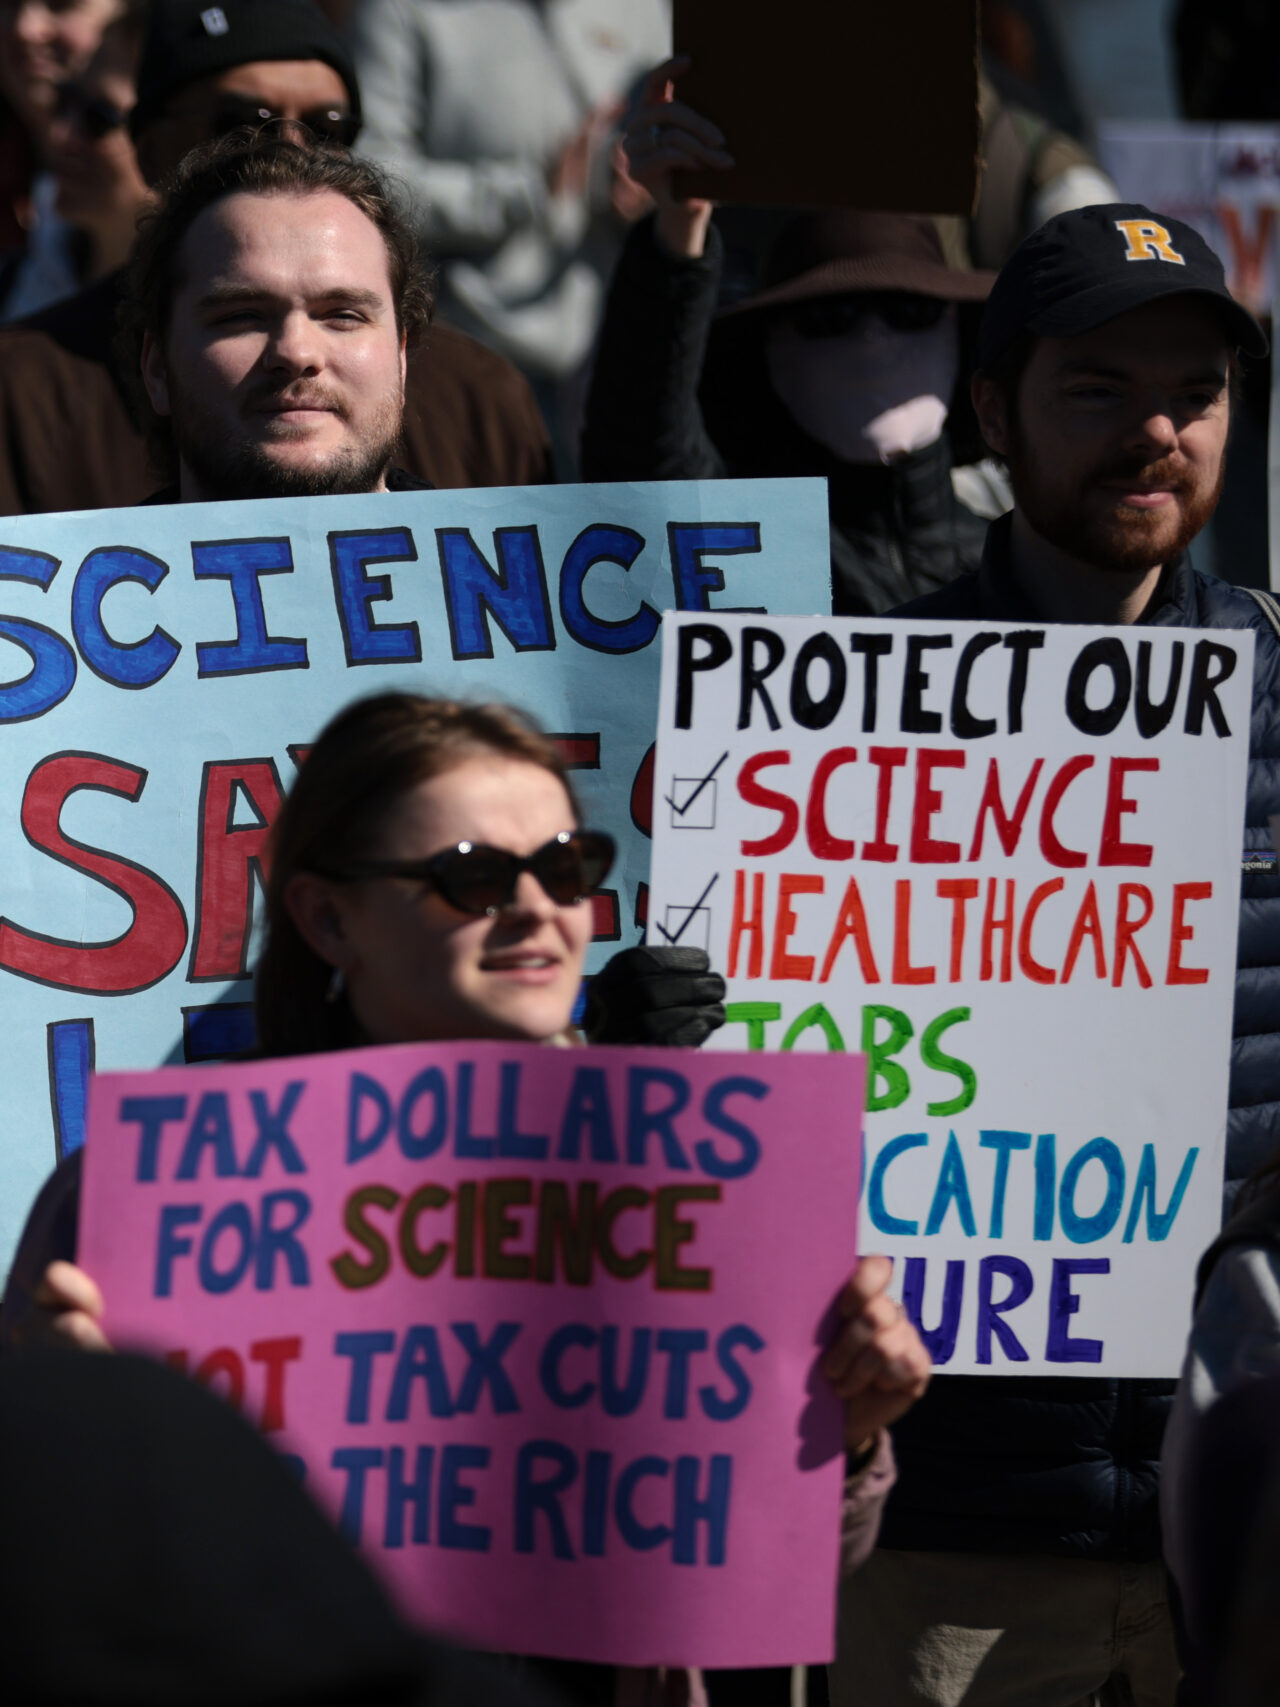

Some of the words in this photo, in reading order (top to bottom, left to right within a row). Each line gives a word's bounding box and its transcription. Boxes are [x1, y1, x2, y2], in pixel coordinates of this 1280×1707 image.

[1115, 219, 1186, 266] R
[674, 624, 1046, 739] PROTECT
[1065, 636, 1238, 740] OUR
[736, 746, 1161, 868] SCIENCE
[726, 869, 1213, 988] HEALTHCARE
[119, 1080, 308, 1184] TAX
[345, 1060, 771, 1180] DOLLARS
[152, 1188, 312, 1299] FOR
[329, 1177, 724, 1293] SCIENCE
[861, 1129, 1200, 1245] CATION
[860, 1254, 1112, 1366] URE
[166, 1335, 303, 1434] OT
[333, 1321, 525, 1425] TAX
[539, 1322, 767, 1422] CUTS
[330, 1443, 492, 1553] THE
[513, 1438, 734, 1568] RICH
